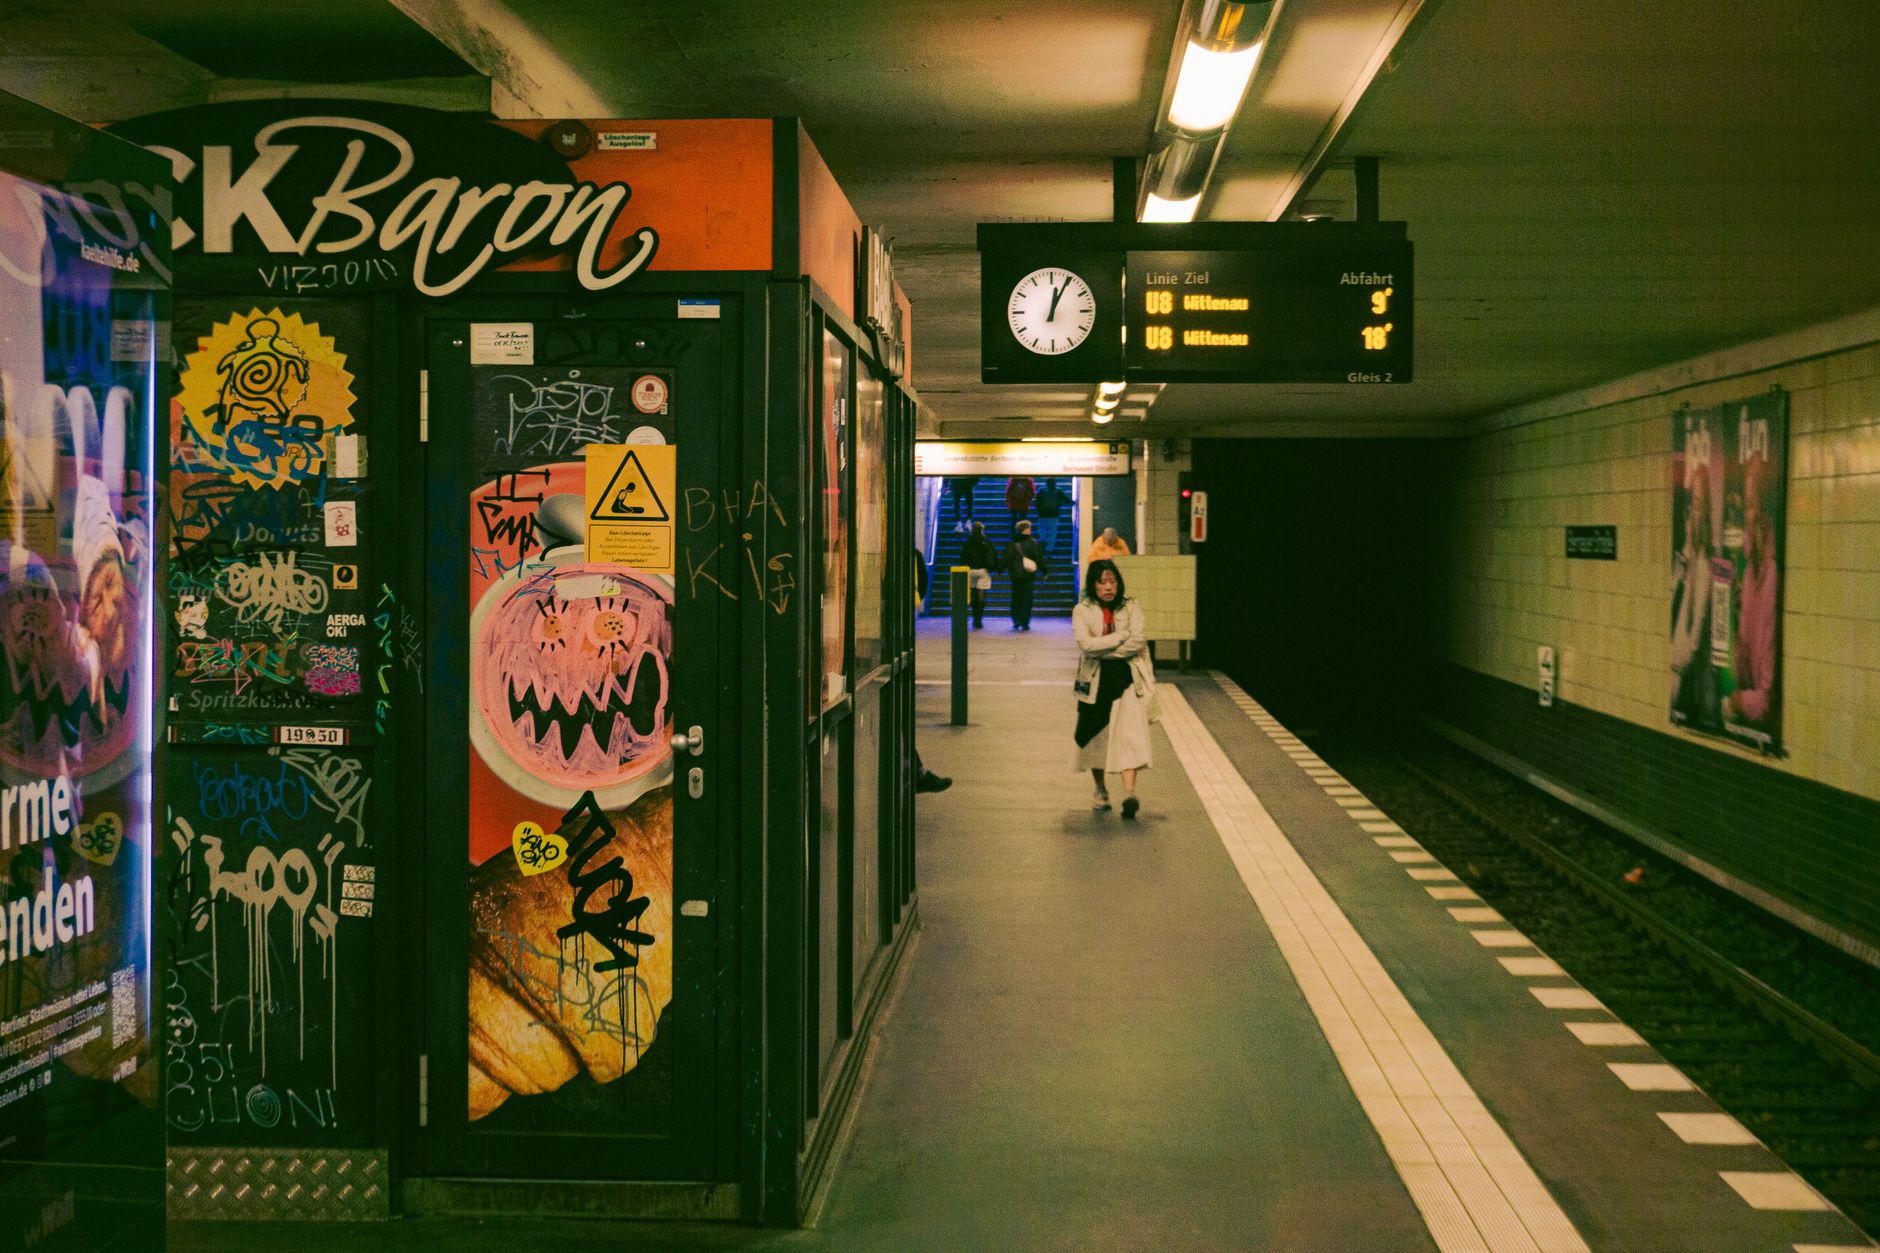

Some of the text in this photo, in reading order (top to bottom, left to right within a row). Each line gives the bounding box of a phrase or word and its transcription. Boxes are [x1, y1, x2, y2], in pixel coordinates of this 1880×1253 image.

[254, 115, 654, 297] Baron
[1146, 271, 1394, 285] Linie Ziel Abfahrt
[1145, 291, 1173, 315] U8
[1183, 294, 1249, 312] Wittenau
[1145, 326, 1173, 350] U8
[1183, 330, 1249, 347] Wittenau
[1347, 371, 1393, 383] Gleis 2
[327, 614, 366, 626] AERGA
